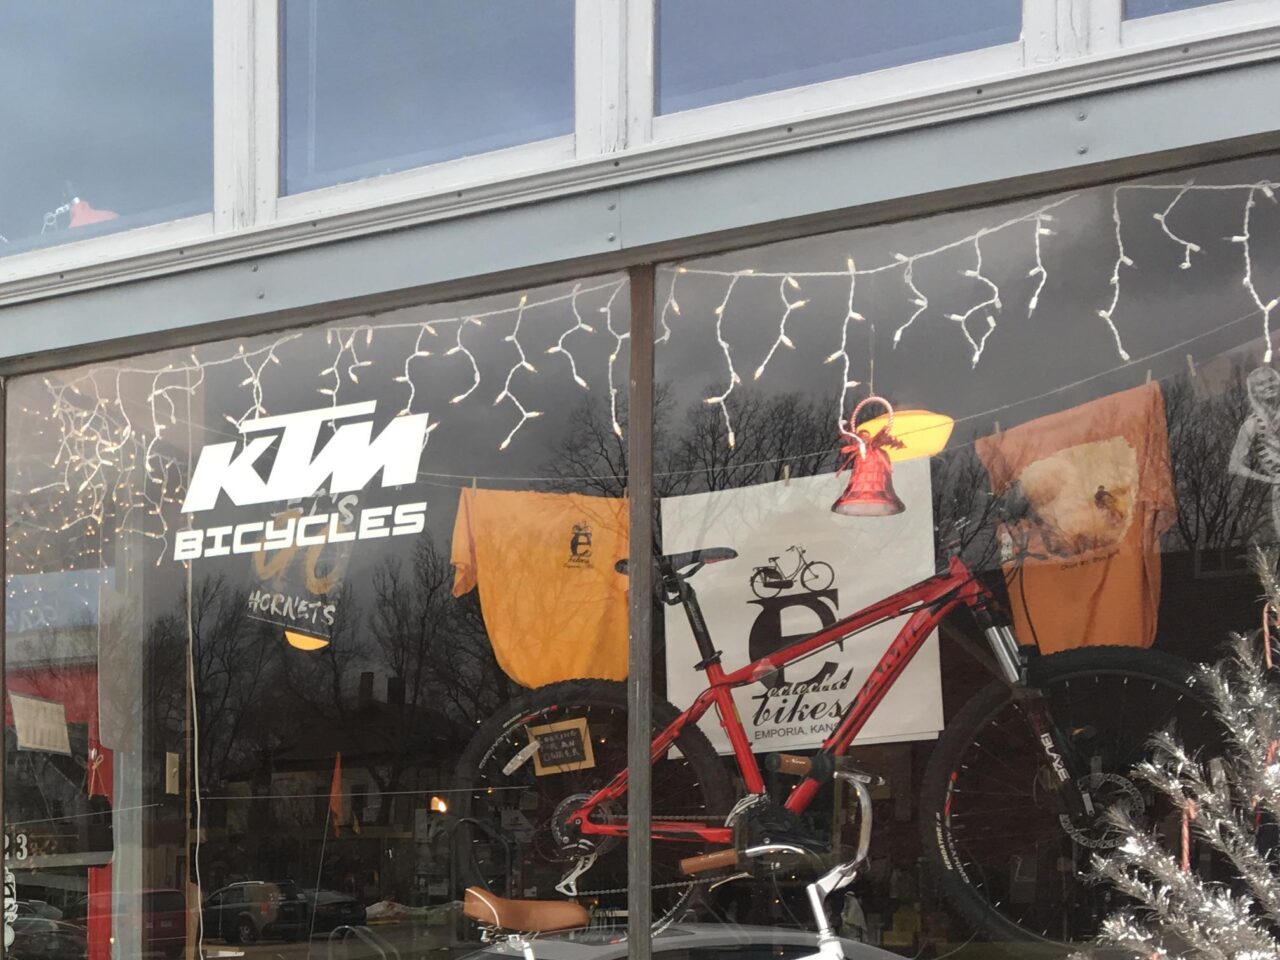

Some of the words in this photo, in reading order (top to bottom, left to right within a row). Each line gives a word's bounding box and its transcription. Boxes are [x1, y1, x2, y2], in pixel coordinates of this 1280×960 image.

[181, 400, 429, 513] KTM
[173, 502, 428, 561] BICYCLES
[247, 590, 337, 626] HORNETS
[751, 690, 860, 727] bikes
[754, 725, 807, 740] EMPORIA,
